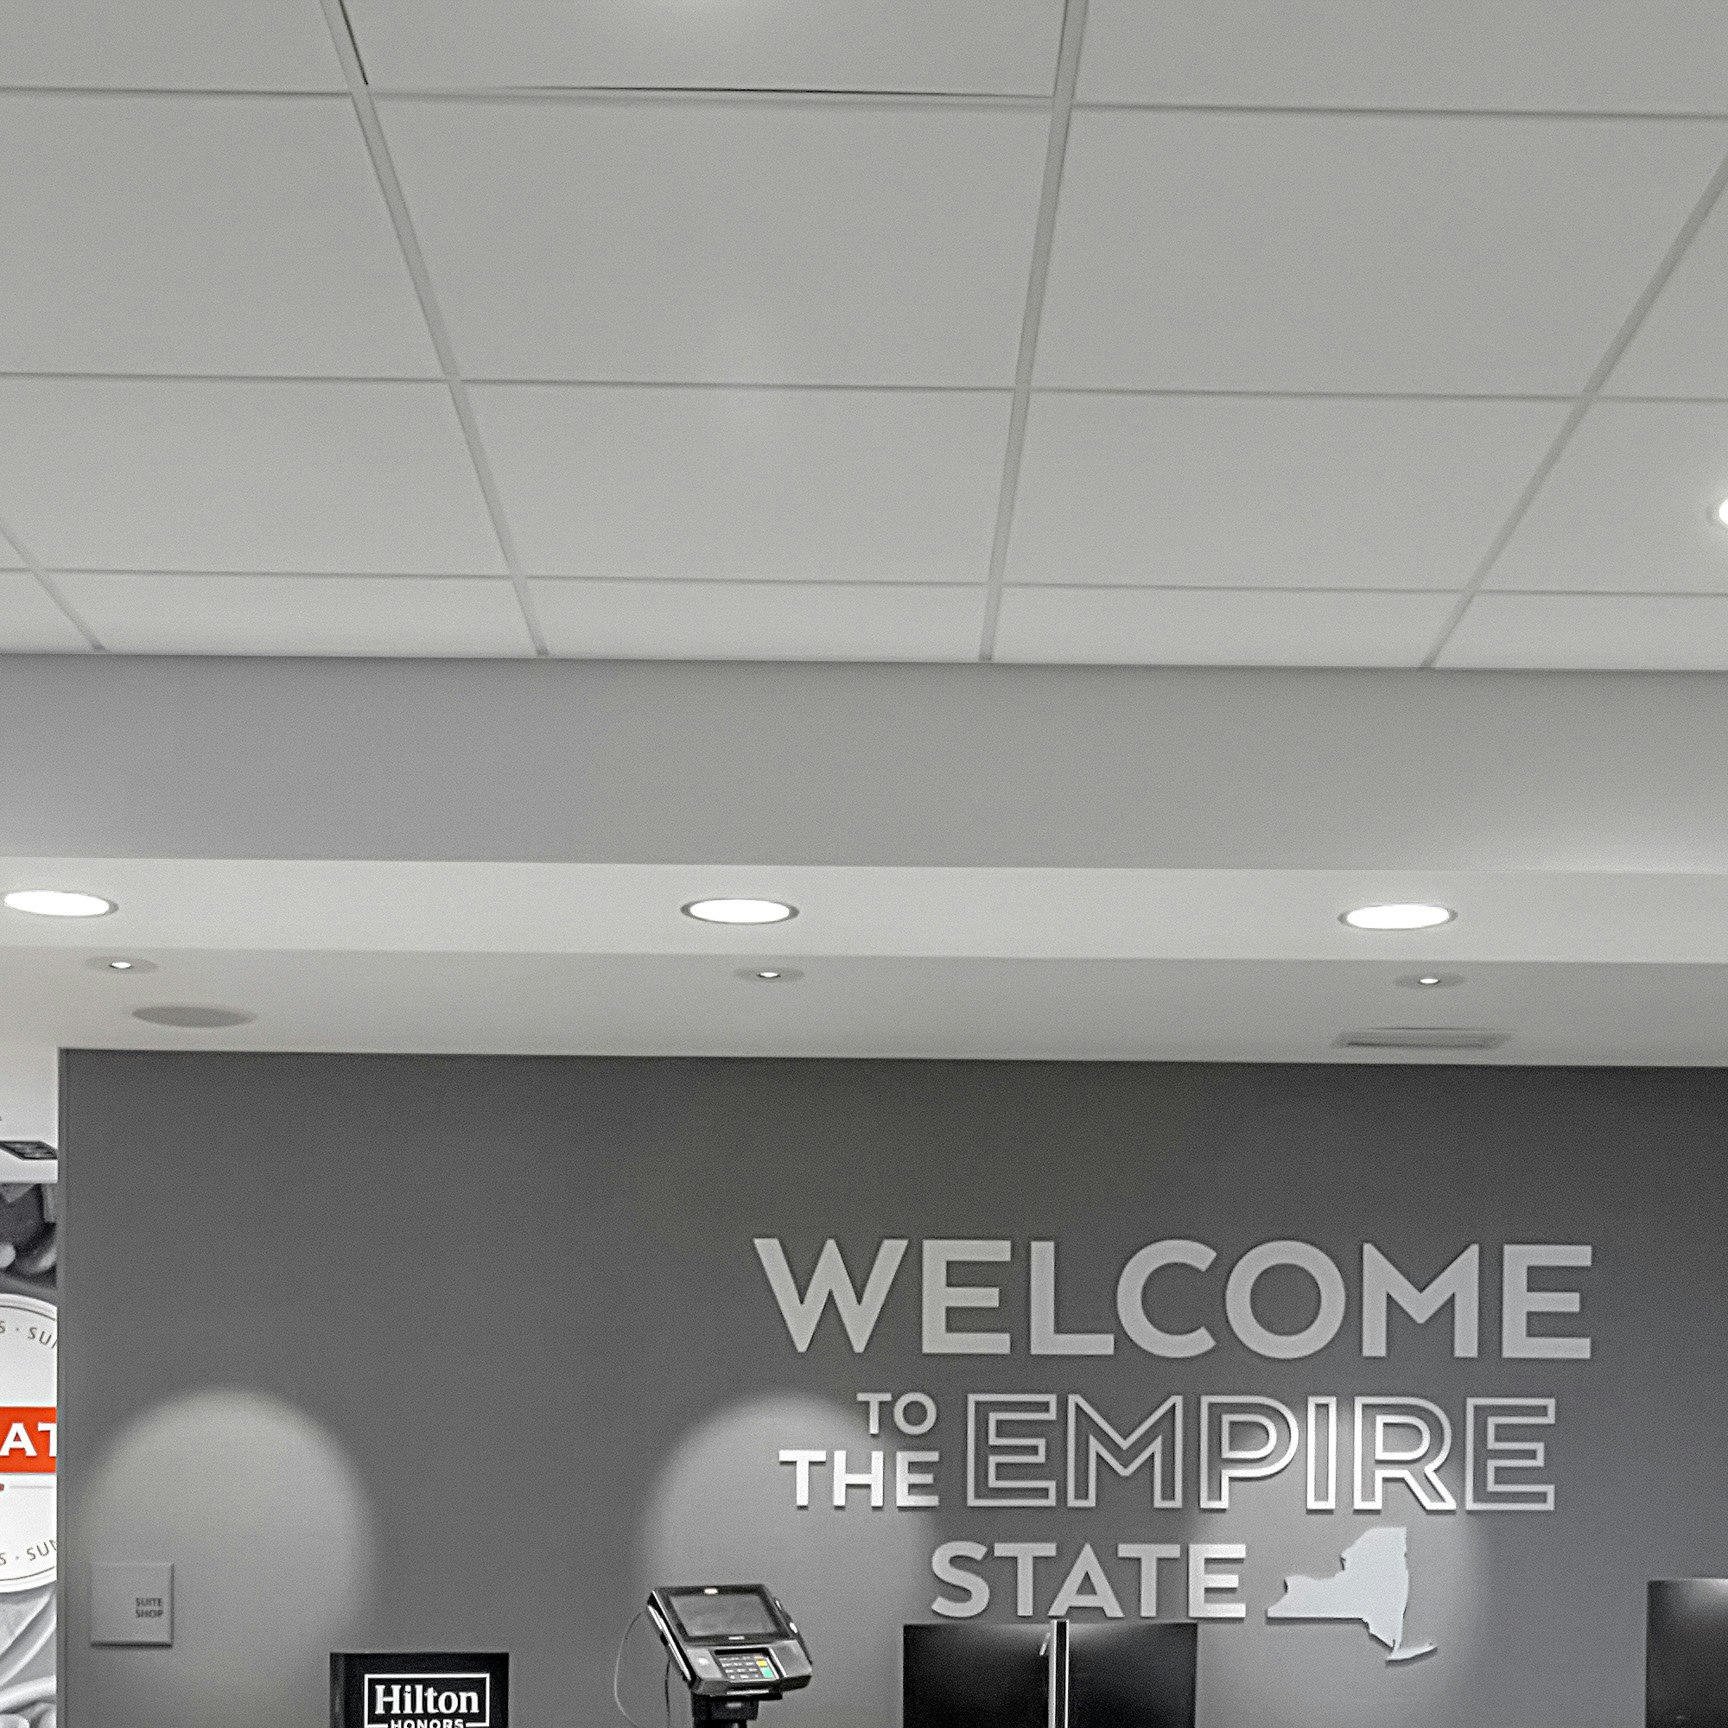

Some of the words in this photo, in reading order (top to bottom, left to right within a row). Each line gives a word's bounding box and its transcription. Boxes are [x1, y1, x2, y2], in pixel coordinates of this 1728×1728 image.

[754, 1238, 1592, 1360] WELCOME
[856, 1392, 938, 1436] TO
[778, 1450, 940, 1508] THE
[966, 1392, 1557, 1512] EMPIRE
[929, 1540, 1247, 1619] STATE
[135, 1609, 164, 1618] SHOP
[374, 1684, 480, 1714] Hilton
